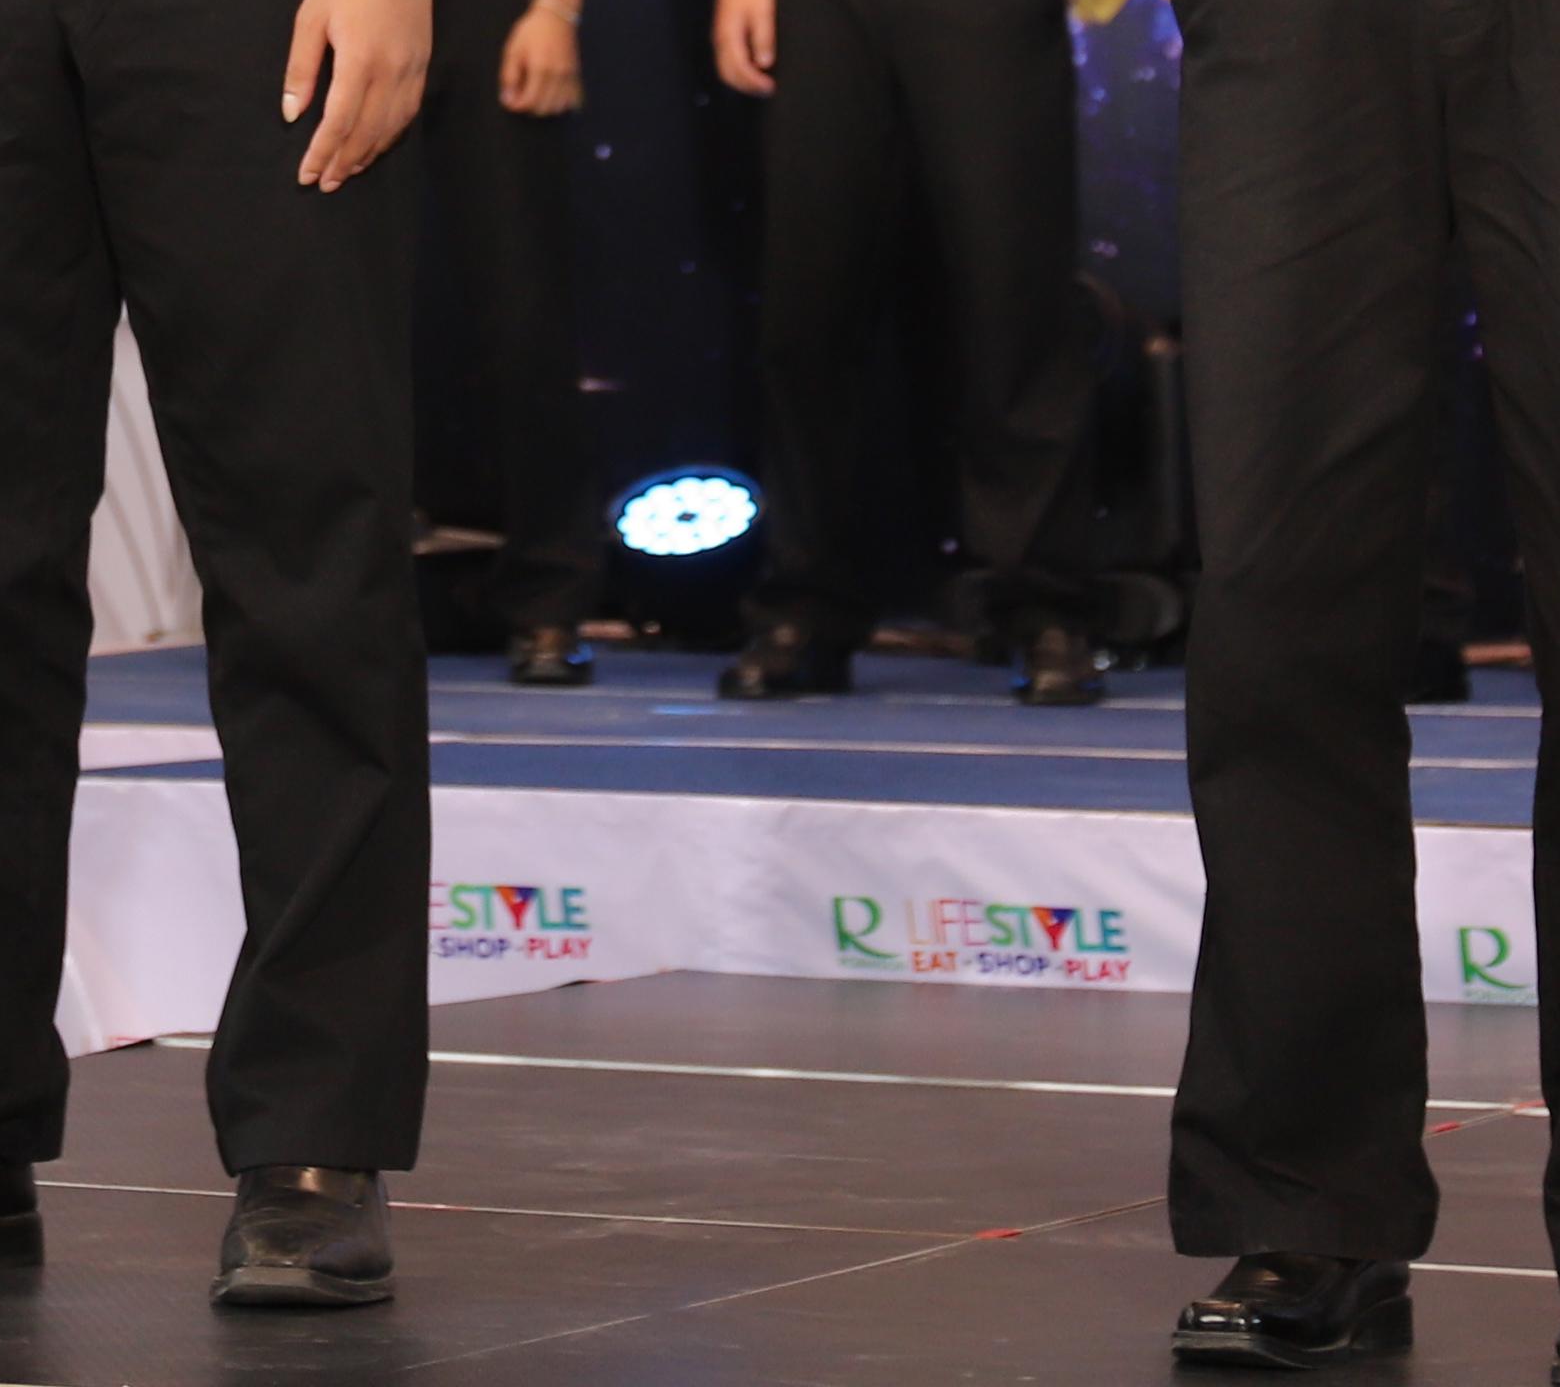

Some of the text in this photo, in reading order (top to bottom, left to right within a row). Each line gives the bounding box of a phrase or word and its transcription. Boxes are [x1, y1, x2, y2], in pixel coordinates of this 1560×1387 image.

[905, 898, 1128, 954] LIFESTYLE
[438, 935, 593, 960] SHOP PLAY
[912, 951, 958, 974] EAT
[976, 951, 1051, 976] SHOP
[1063, 958, 1131, 982] PLAY
